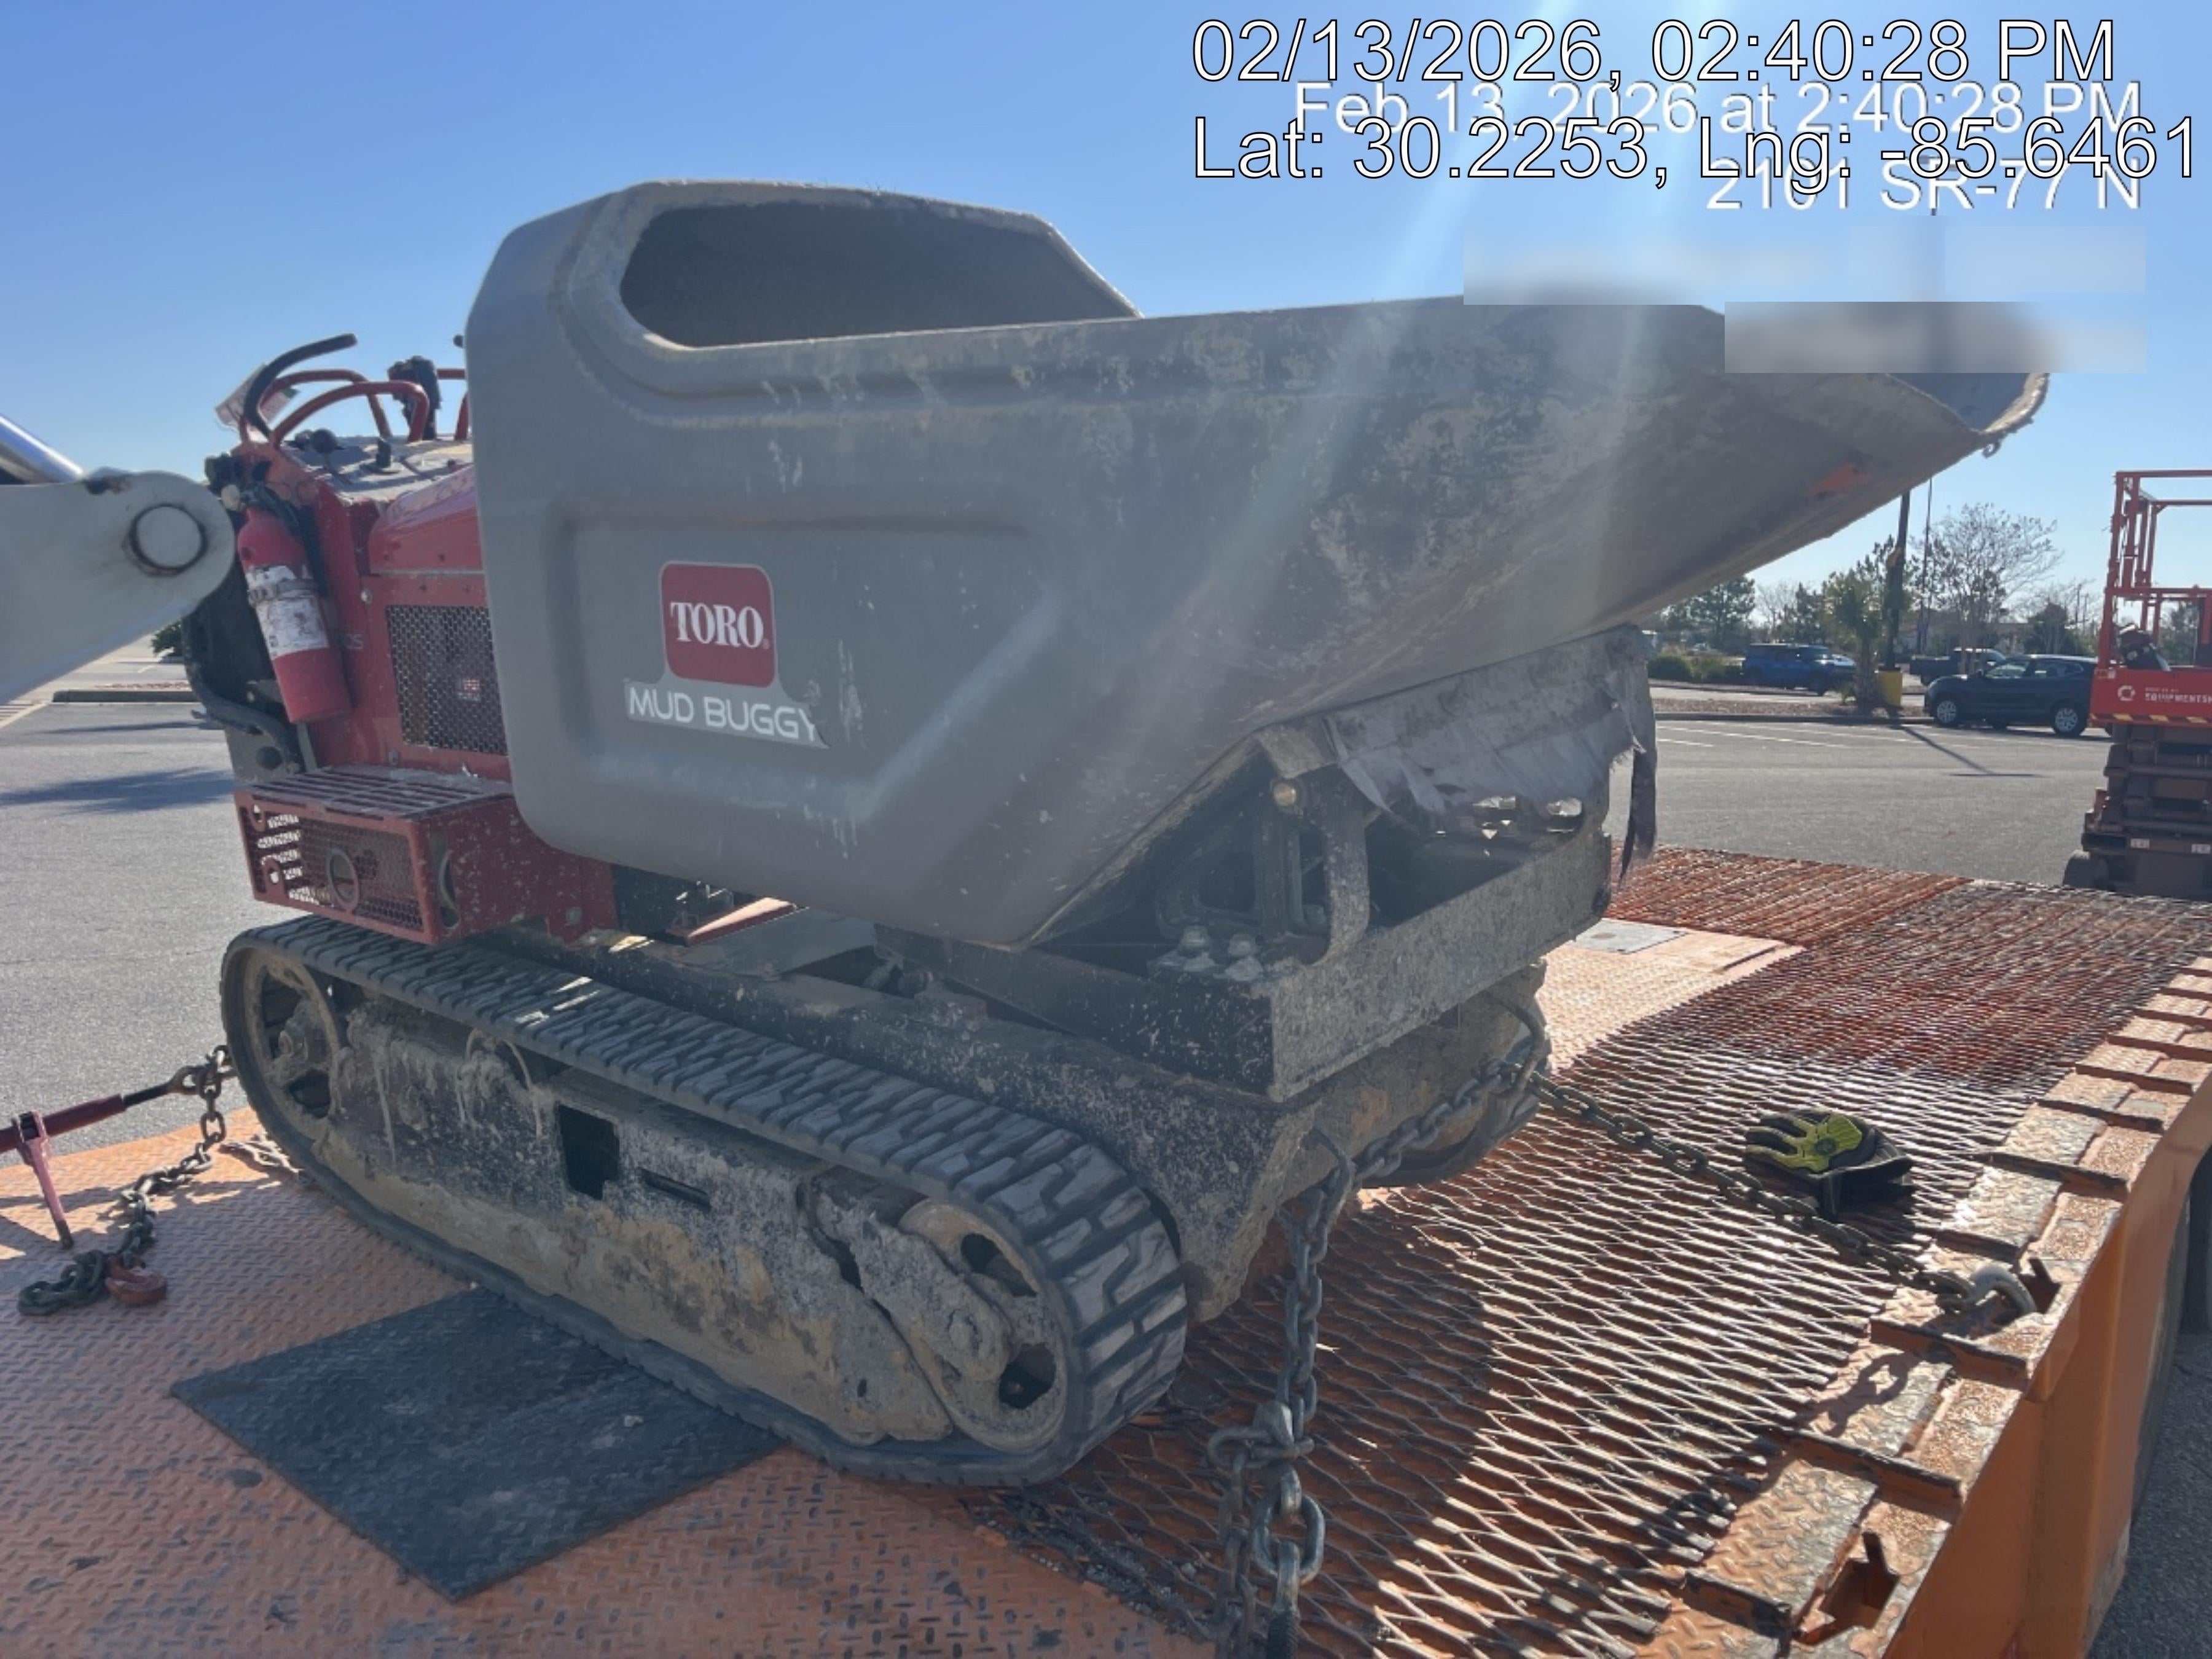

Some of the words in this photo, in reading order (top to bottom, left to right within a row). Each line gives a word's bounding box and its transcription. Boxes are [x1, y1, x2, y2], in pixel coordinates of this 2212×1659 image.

[670, 602, 764, 649] TORO
[628, 687, 694, 723] MUD
[703, 697, 816, 741] BUGGY
